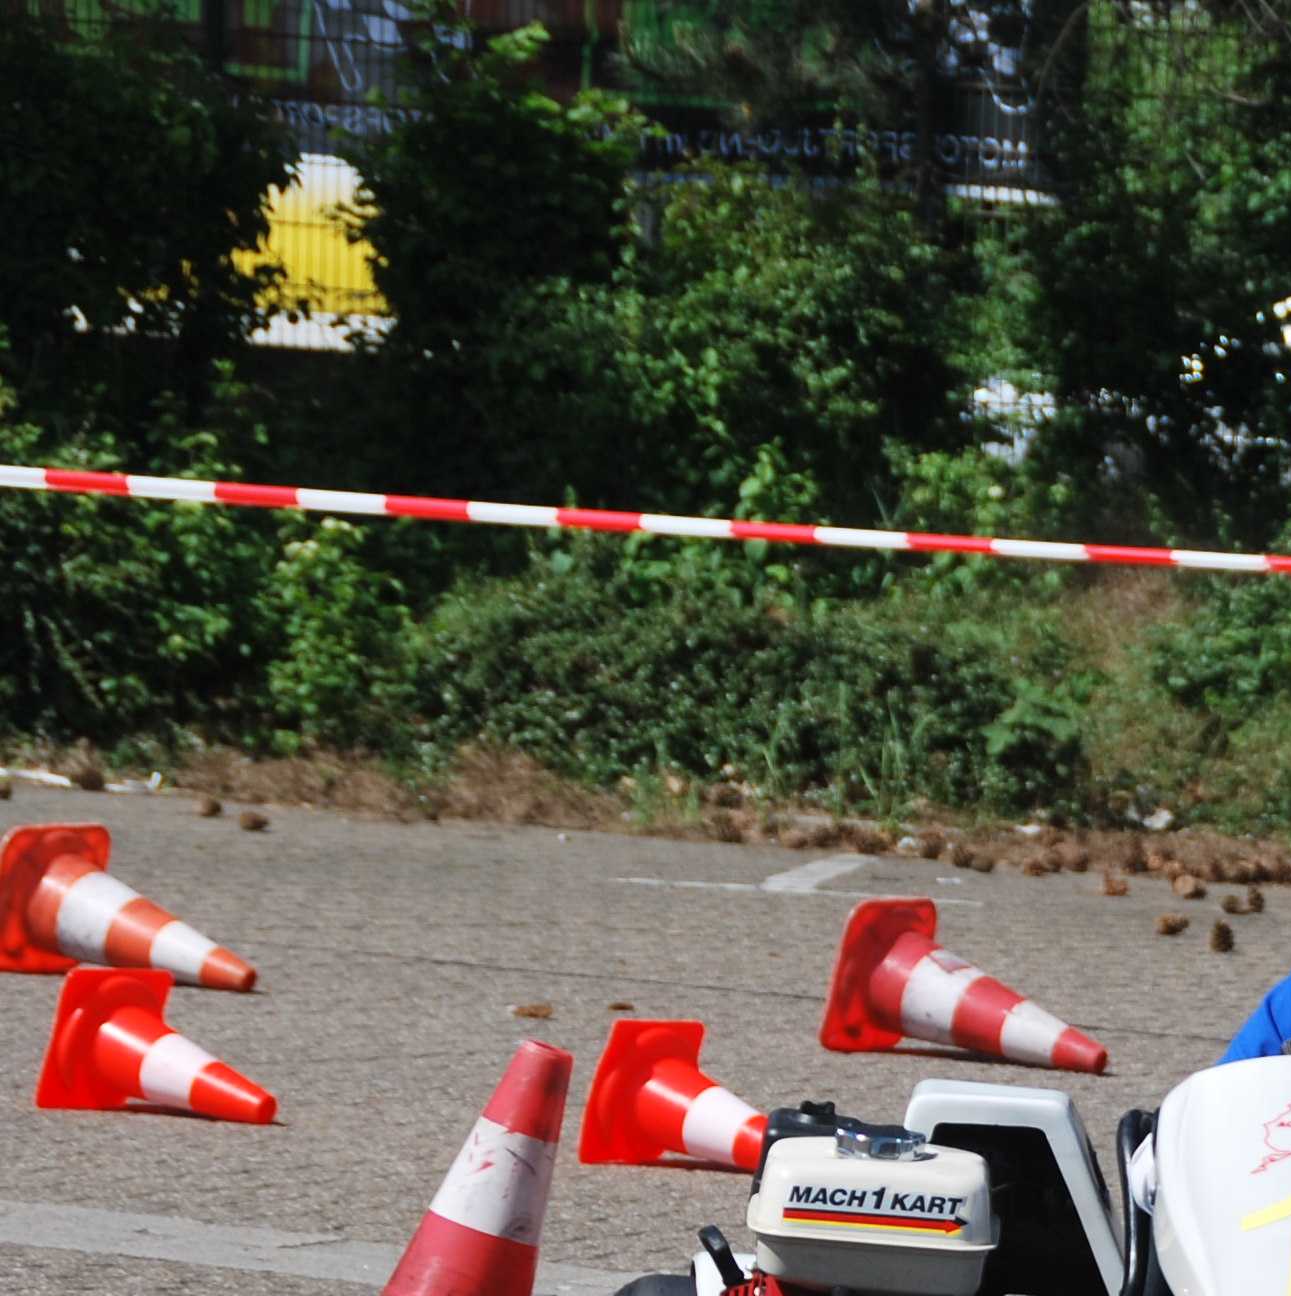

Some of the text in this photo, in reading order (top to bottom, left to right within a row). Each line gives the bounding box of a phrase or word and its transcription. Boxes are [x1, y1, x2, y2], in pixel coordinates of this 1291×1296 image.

[789, 1186, 964, 1215] MACH 1 KART
